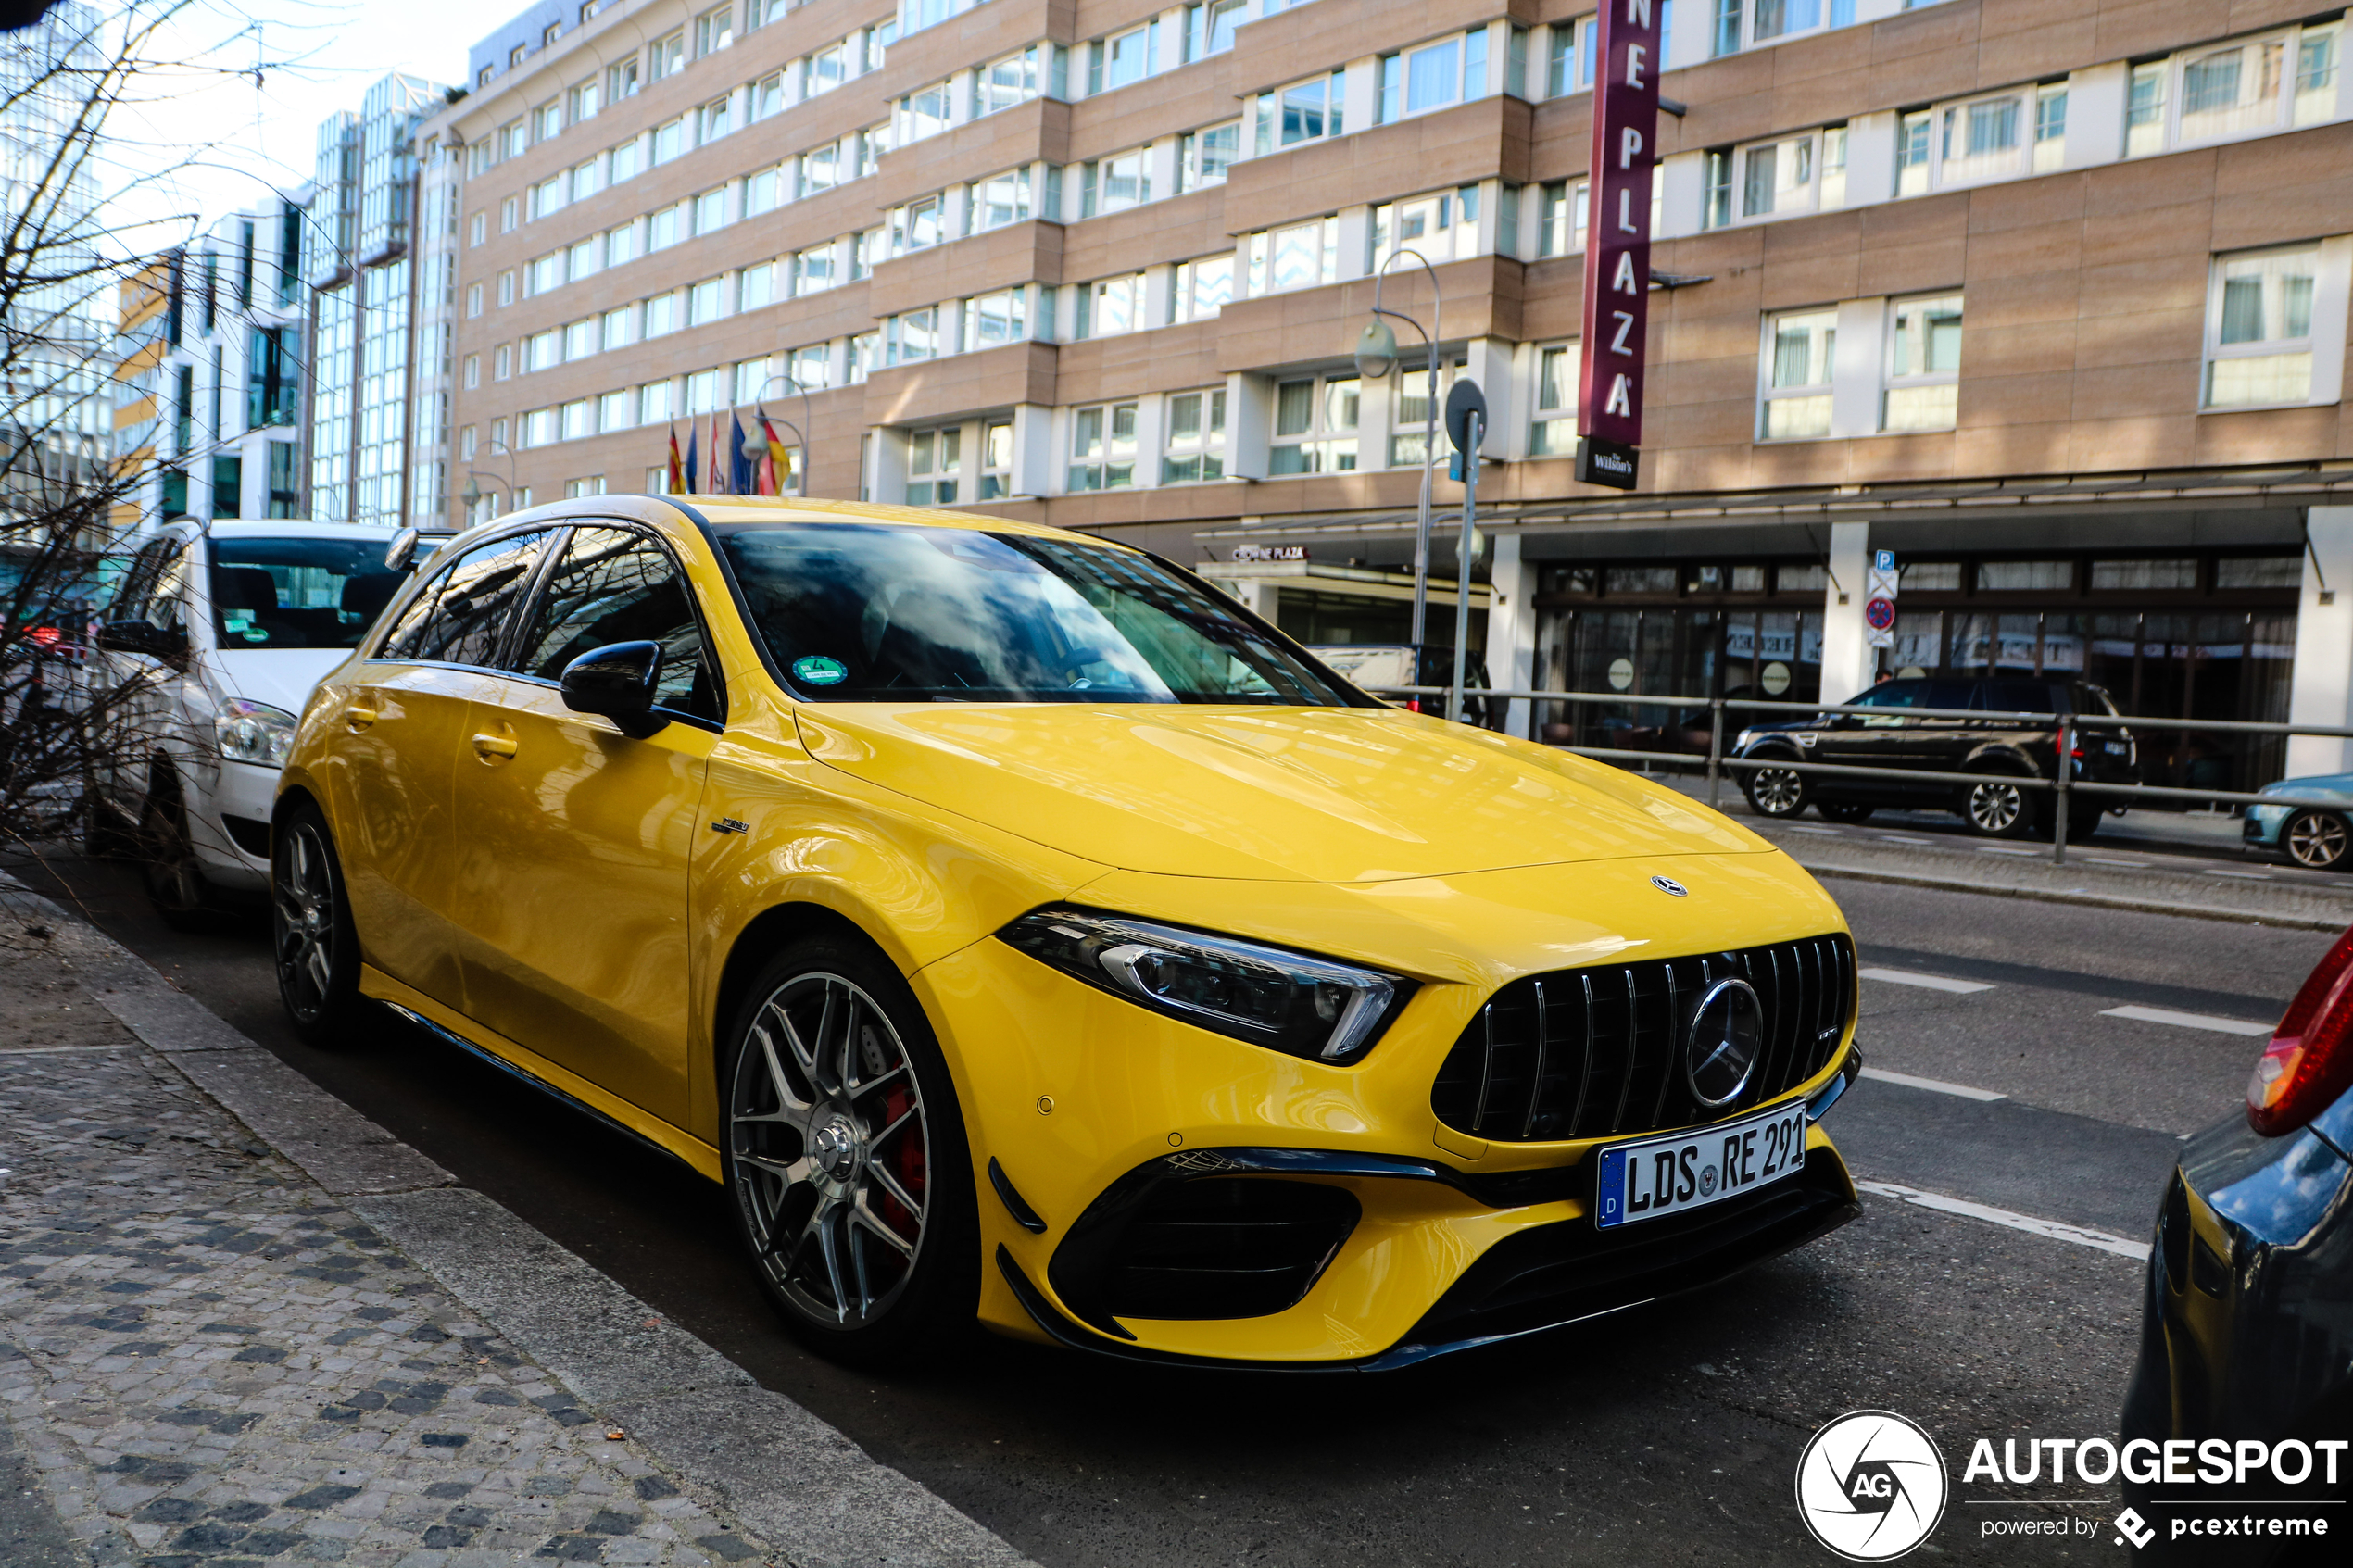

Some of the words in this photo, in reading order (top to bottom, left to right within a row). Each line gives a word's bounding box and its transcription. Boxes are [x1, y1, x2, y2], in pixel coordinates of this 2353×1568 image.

[1594, 454, 1632, 474] Wilson's
[1274, 546, 1304, 560] PLAZA
[1880, 552, 1891, 569] P
[812, 659, 824, 671] 4
[1628, 1145, 1698, 1213] LDS
[1721, 1129, 1757, 1191] RE
[1762, 1111, 1804, 1177] 291
[1606, 1198, 1617, 1214] D
